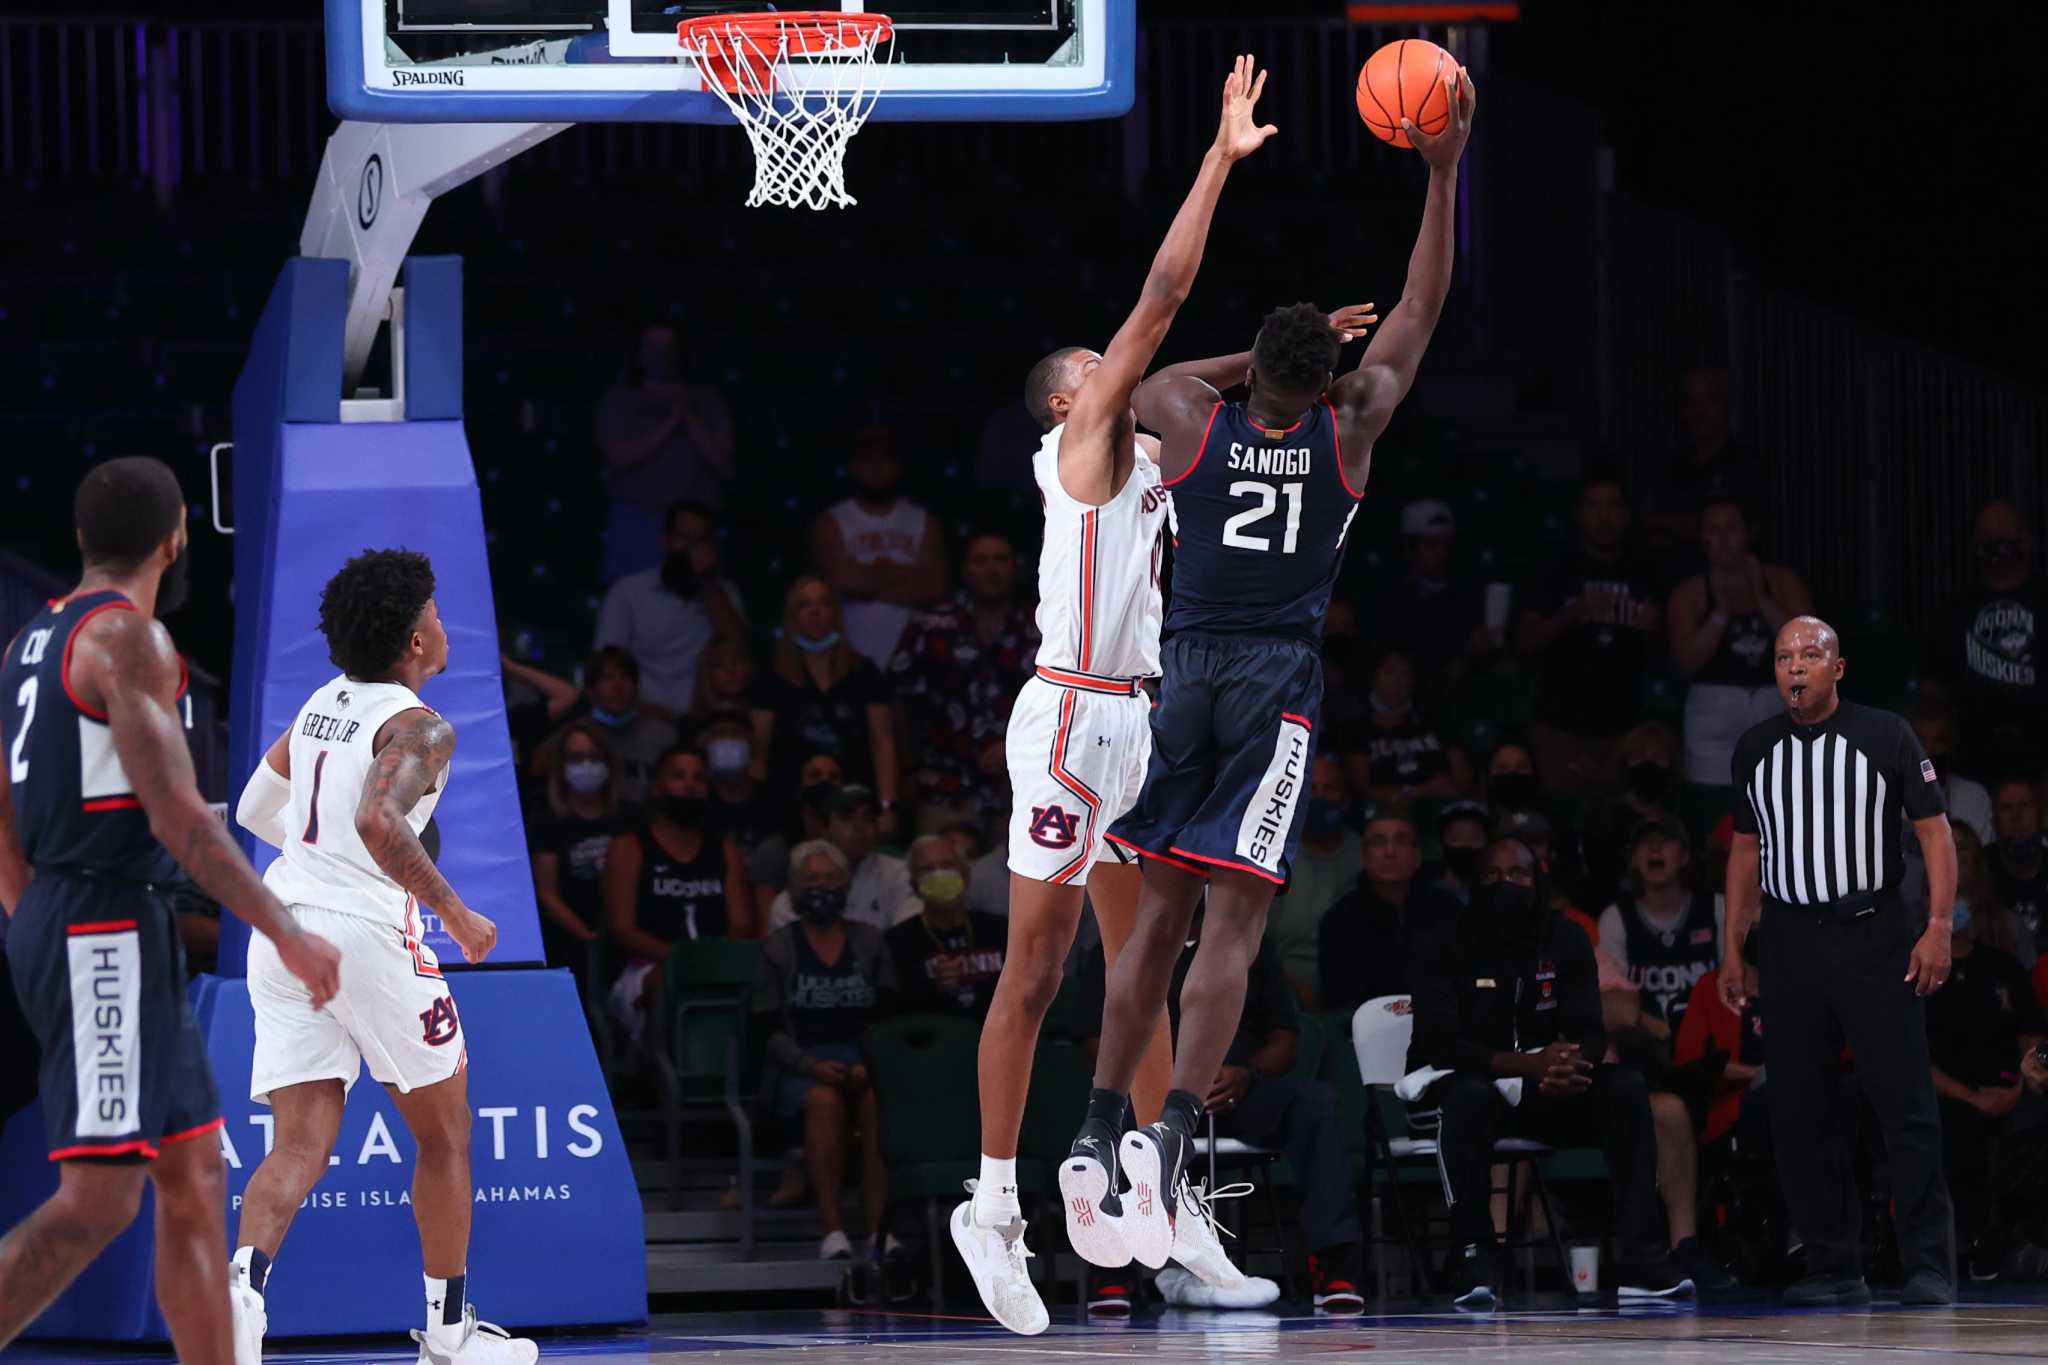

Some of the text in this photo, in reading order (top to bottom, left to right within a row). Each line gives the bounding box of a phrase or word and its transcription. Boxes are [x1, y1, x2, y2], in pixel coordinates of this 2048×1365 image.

[392, 70, 464, 87] SPALDING
[1227, 442, 1311, 475] SANOGO
[1141, 484, 1167, 513] AUB
[1222, 480, 1303, 554] 21
[11, 675, 39, 784] 2
[302, 750, 328, 845] 1
[1250, 737, 1302, 865] HUSKIES
[93, 948, 125, 1121] HUSKIES
[216, 1104, 602, 1168] ATATIS
[232, 1184, 571, 1211] PISE ISLA AHAMAS
